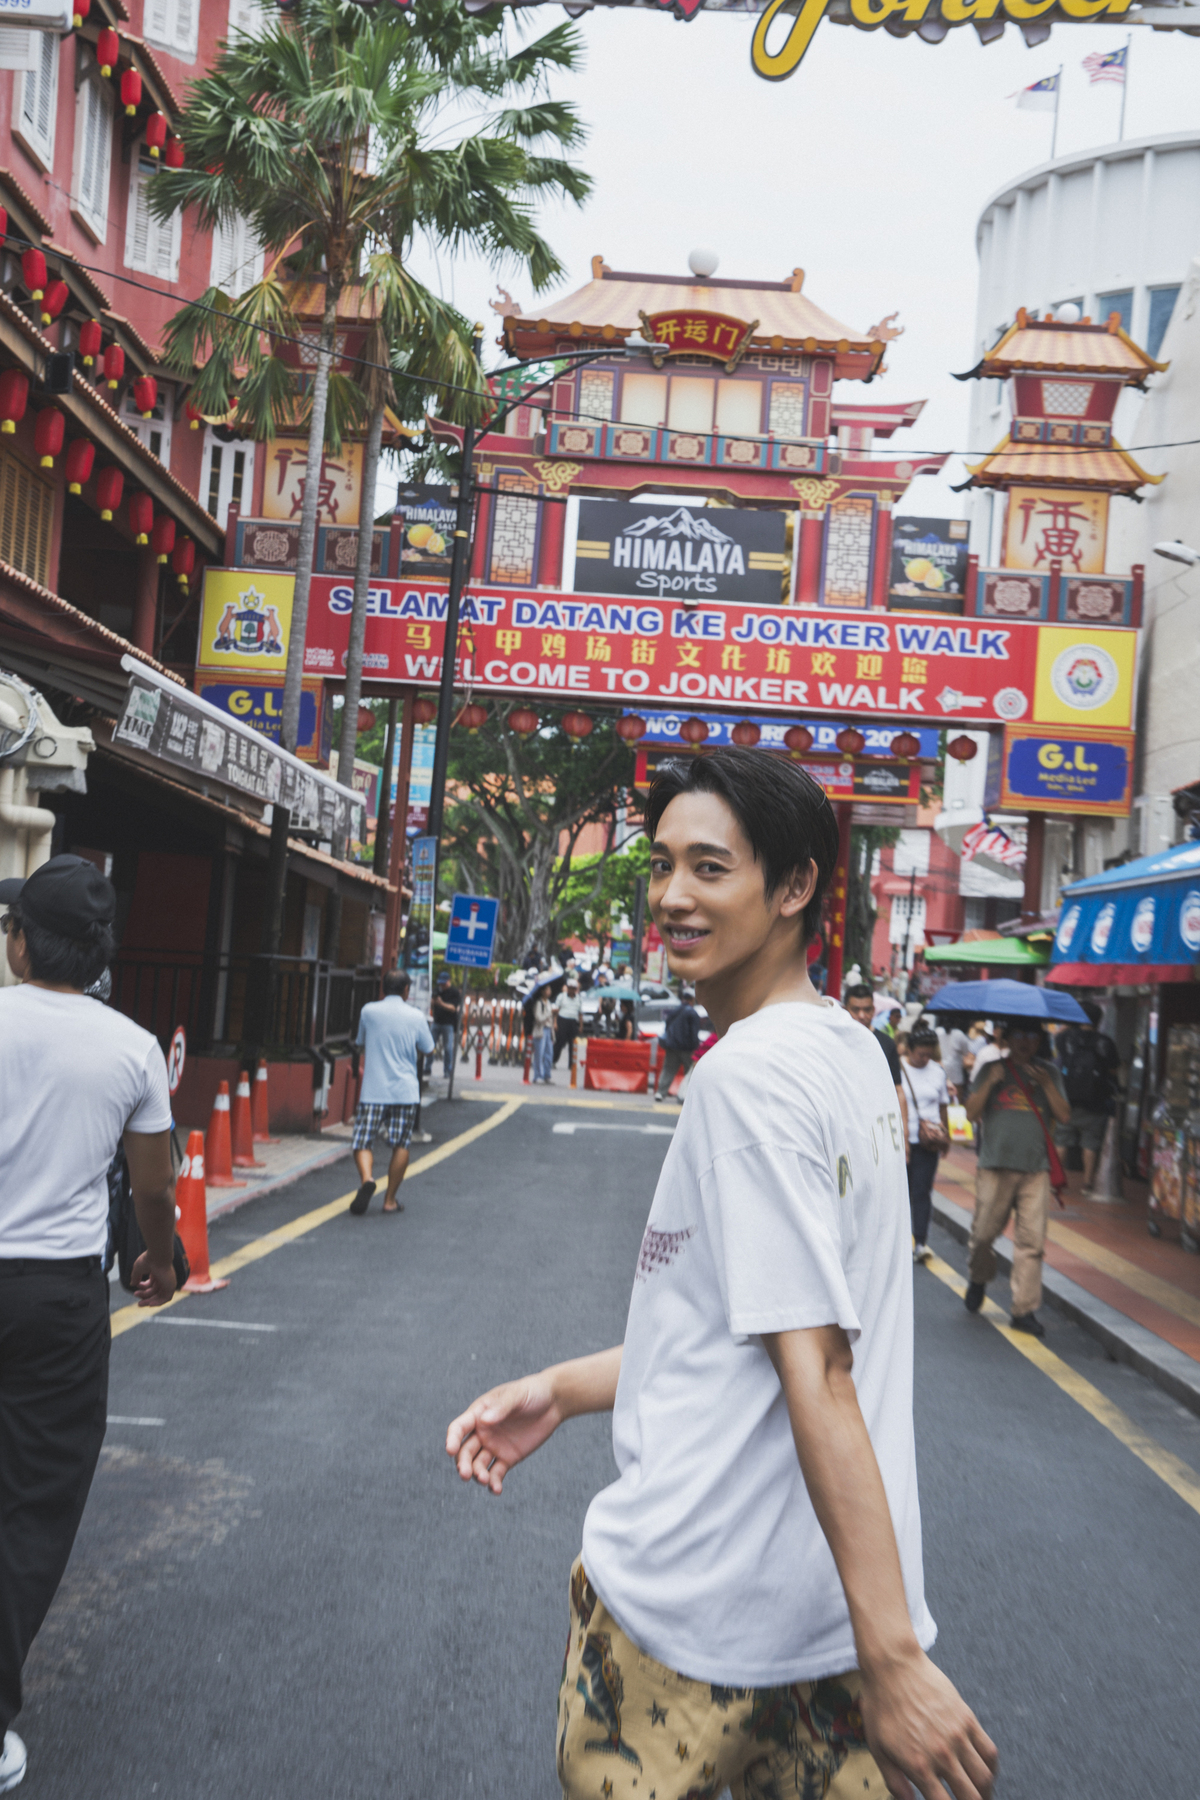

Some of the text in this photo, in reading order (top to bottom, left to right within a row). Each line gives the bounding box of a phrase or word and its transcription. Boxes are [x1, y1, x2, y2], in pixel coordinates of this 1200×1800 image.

[656, 319, 739, 350] 开运门
[406, 508, 457, 522] HIMALAYA
[613, 536, 746, 576] HIMALAYA
[904, 541, 958, 558] HIMALAYA
[635, 571, 718, 598] Sports
[514, 600, 662, 635] DATANG
[672, 611, 724, 639] KE
[733, 615, 887, 650] JONKER
[898, 626, 1006, 657] WALK
[601, 667, 650, 693] TO
[659, 671, 809, 704] JONKER
[818, 681, 925, 712] WALK
[1037, 743, 1098, 772] G.L.
